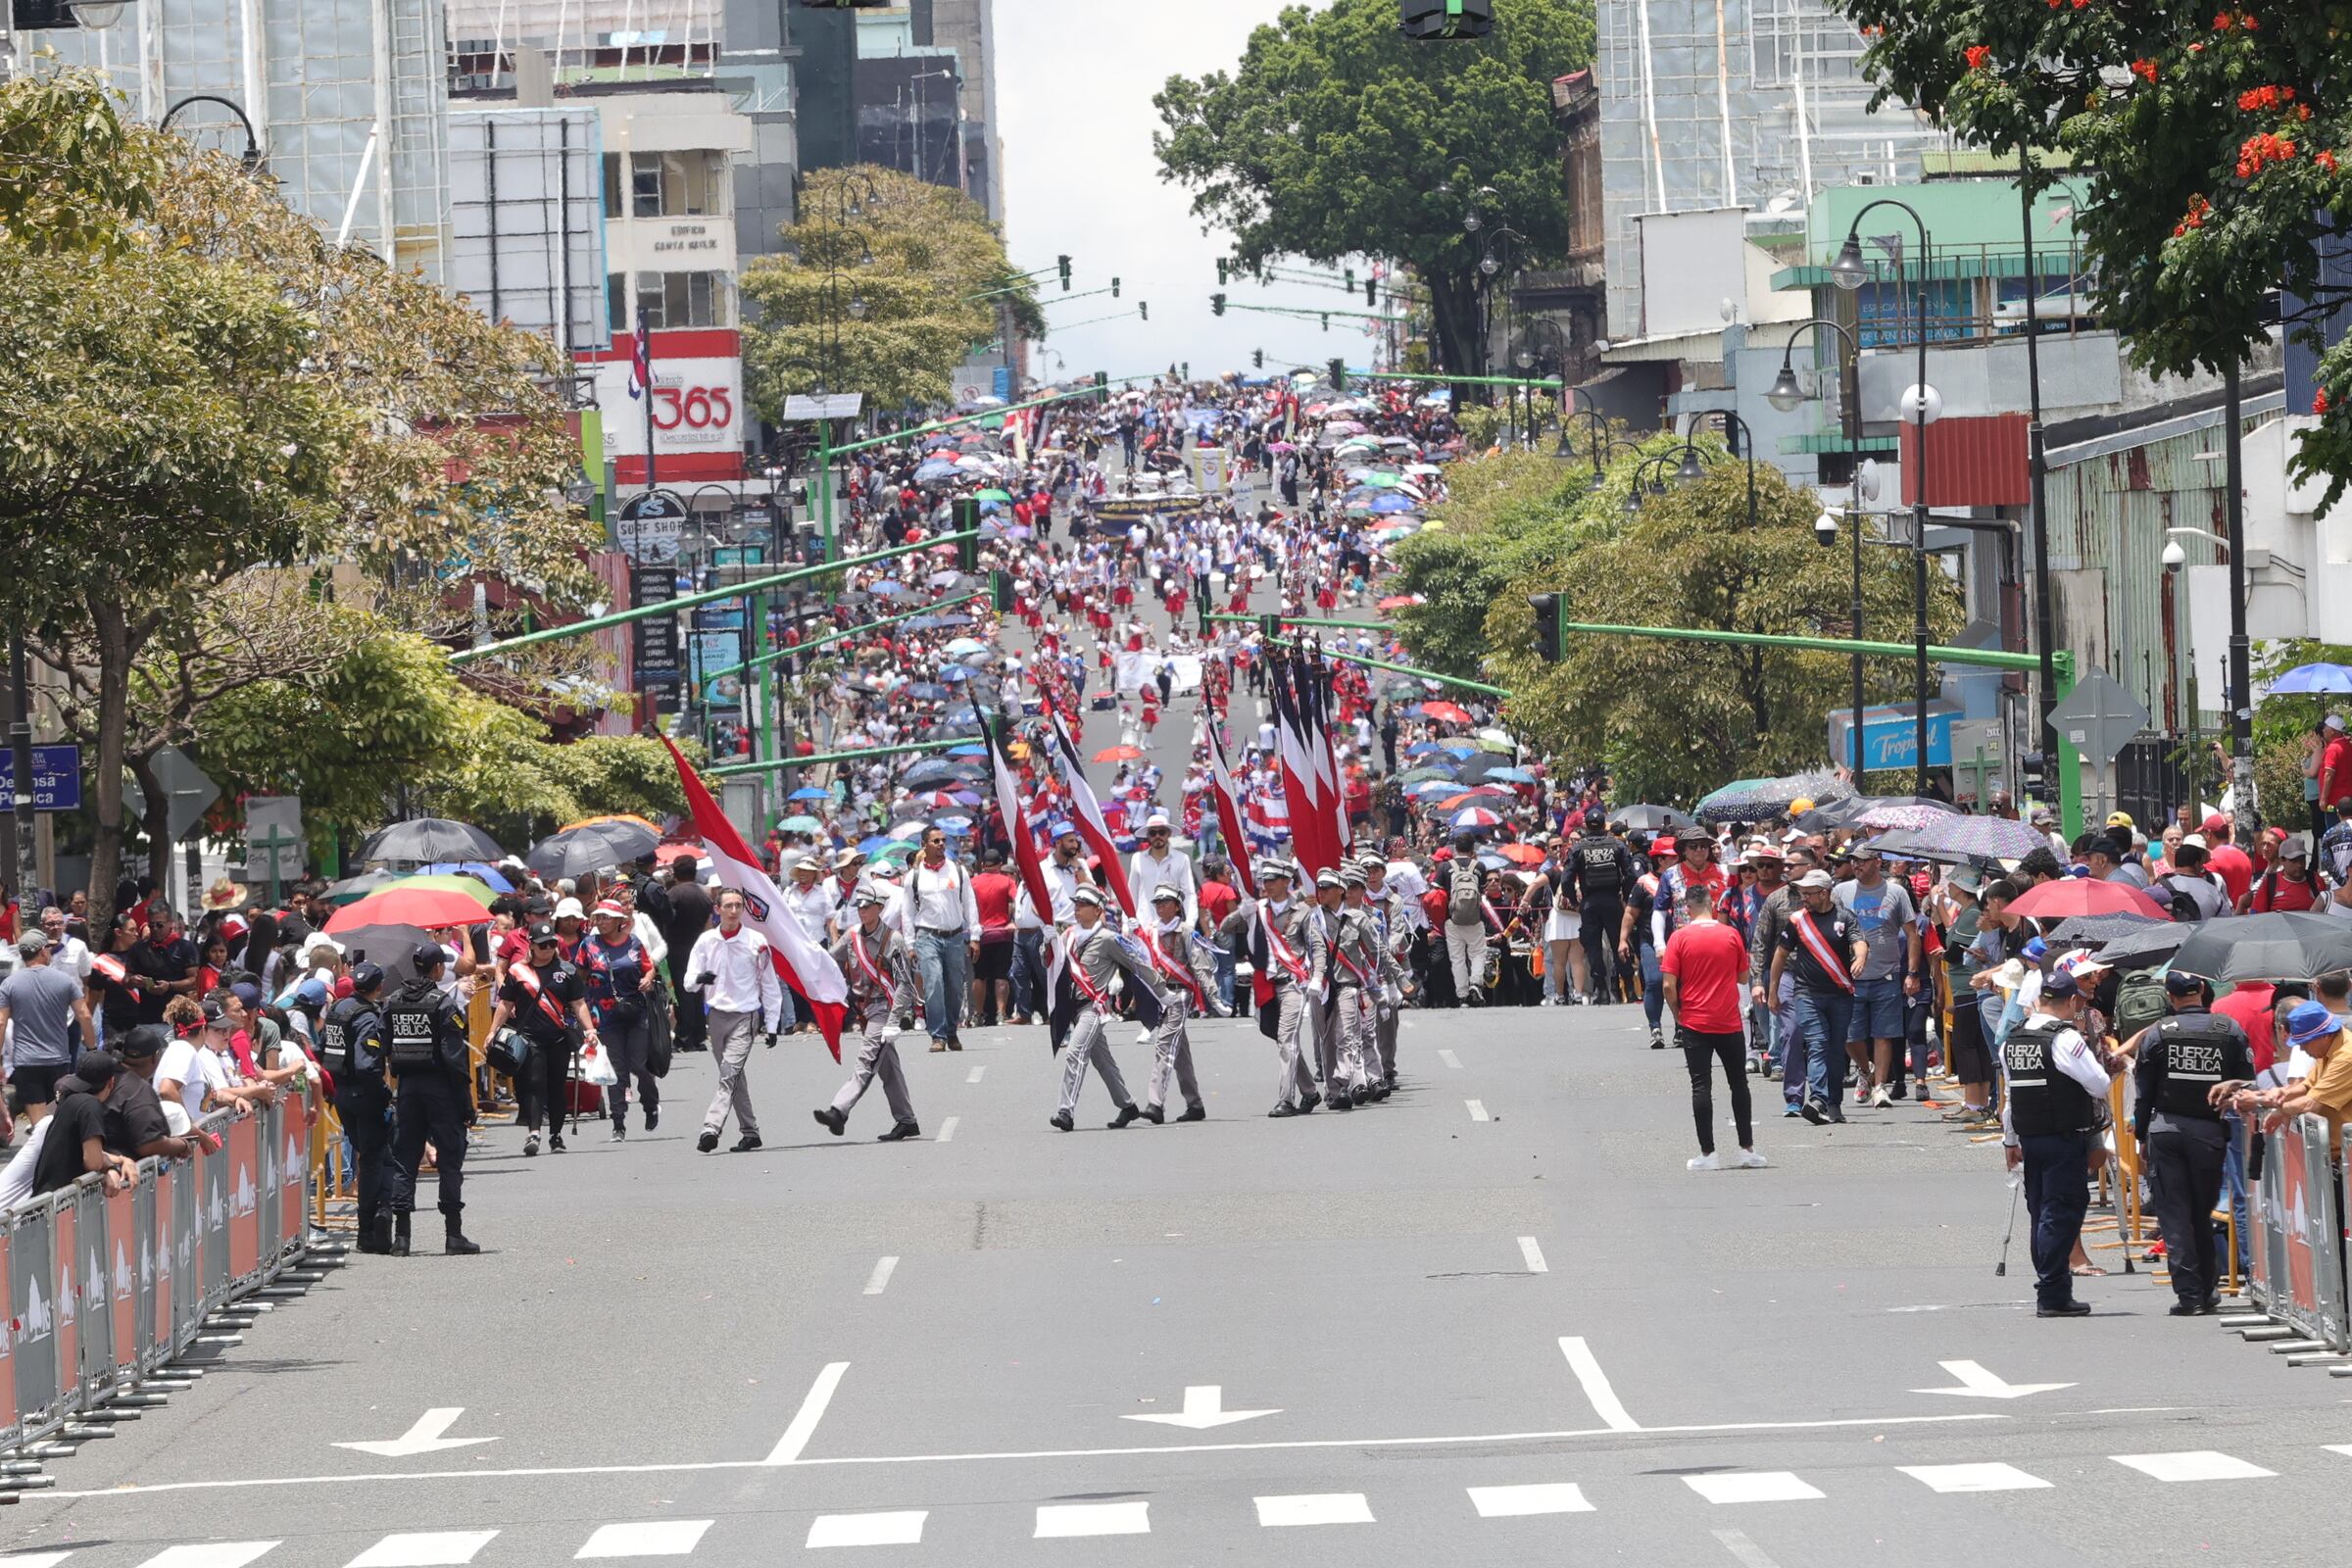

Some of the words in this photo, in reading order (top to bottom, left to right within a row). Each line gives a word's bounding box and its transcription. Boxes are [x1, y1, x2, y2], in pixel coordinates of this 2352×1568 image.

[651, 386, 732, 430] 365
[619, 522, 649, 536] SURF
[654, 520, 684, 534] SHOP
[1871, 722, 1938, 763] Tropial
[0, 775, 56, 789] Densa
[0, 791, 54, 805] Púica
[1584, 848, 1615, 858] FUERZA
[1585, 854, 1615, 863] PUBLICA
[392, 1013, 431, 1025] FUERZA
[393, 1025, 432, 1036] PUBLICA
[2007, 1045, 2043, 1057] FUERZA
[2168, 1045, 2224, 1060] FUERZA
[2007, 1057, 2045, 1070] PUBLICA
[2168, 1057, 2222, 1072] PUBLICA
